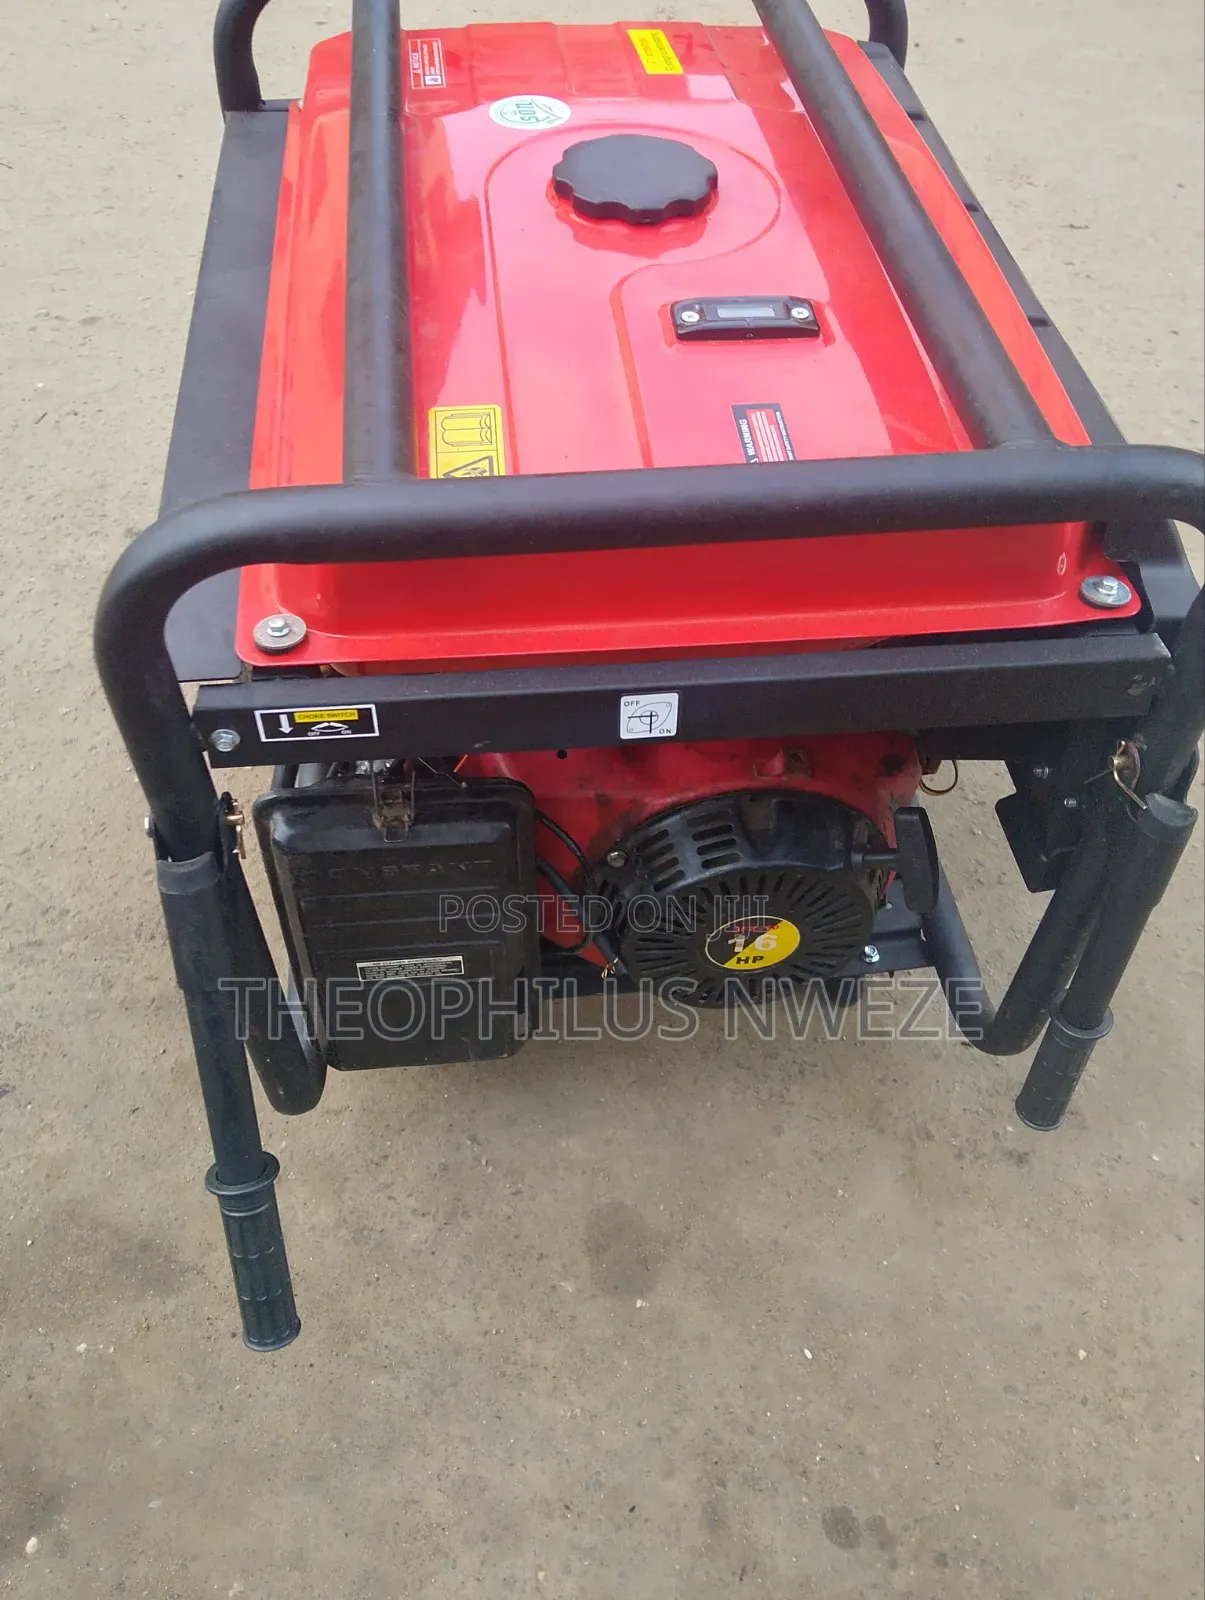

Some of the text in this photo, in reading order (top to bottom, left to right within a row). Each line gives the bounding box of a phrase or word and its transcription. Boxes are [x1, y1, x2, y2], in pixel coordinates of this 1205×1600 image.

[739, 418, 756, 456] WARNING
[728, 934, 777, 952] 16
[736, 955, 765, 965] HP
